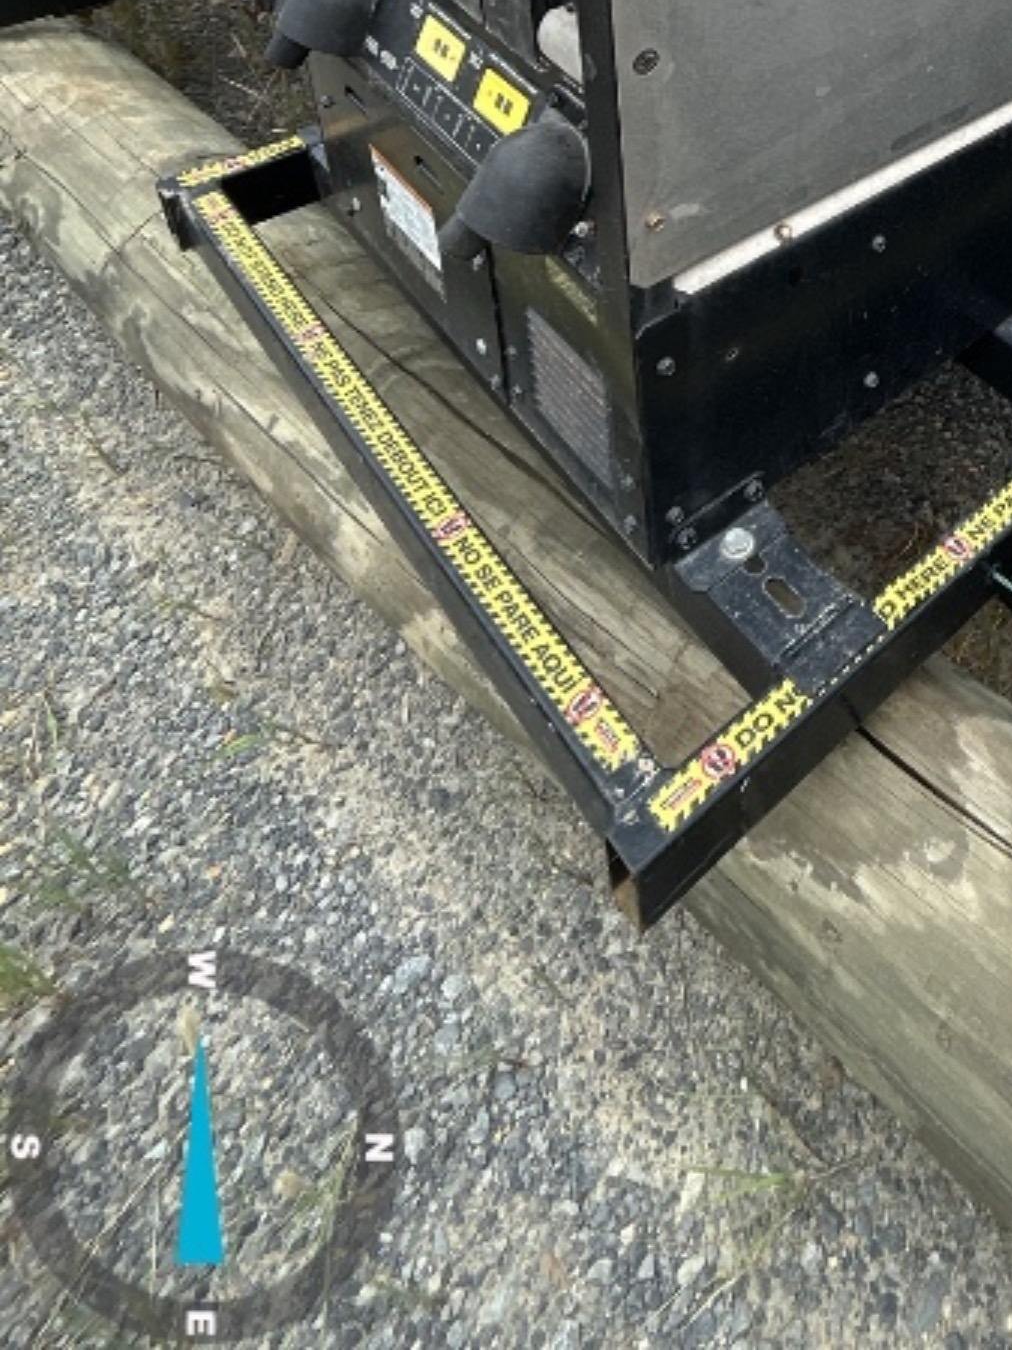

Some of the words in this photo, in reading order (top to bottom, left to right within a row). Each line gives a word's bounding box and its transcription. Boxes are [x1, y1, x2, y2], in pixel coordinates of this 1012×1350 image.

[322, 358, 353, 391] PAS
[344, 386, 384, 433] TENEZ
[376, 430, 430, 494] DEBOUT
[453, 536, 482, 567] NO
[475, 564, 503, 592] SE
[493, 588, 542, 645] PARE
[895, 554, 950, 601] HERE
